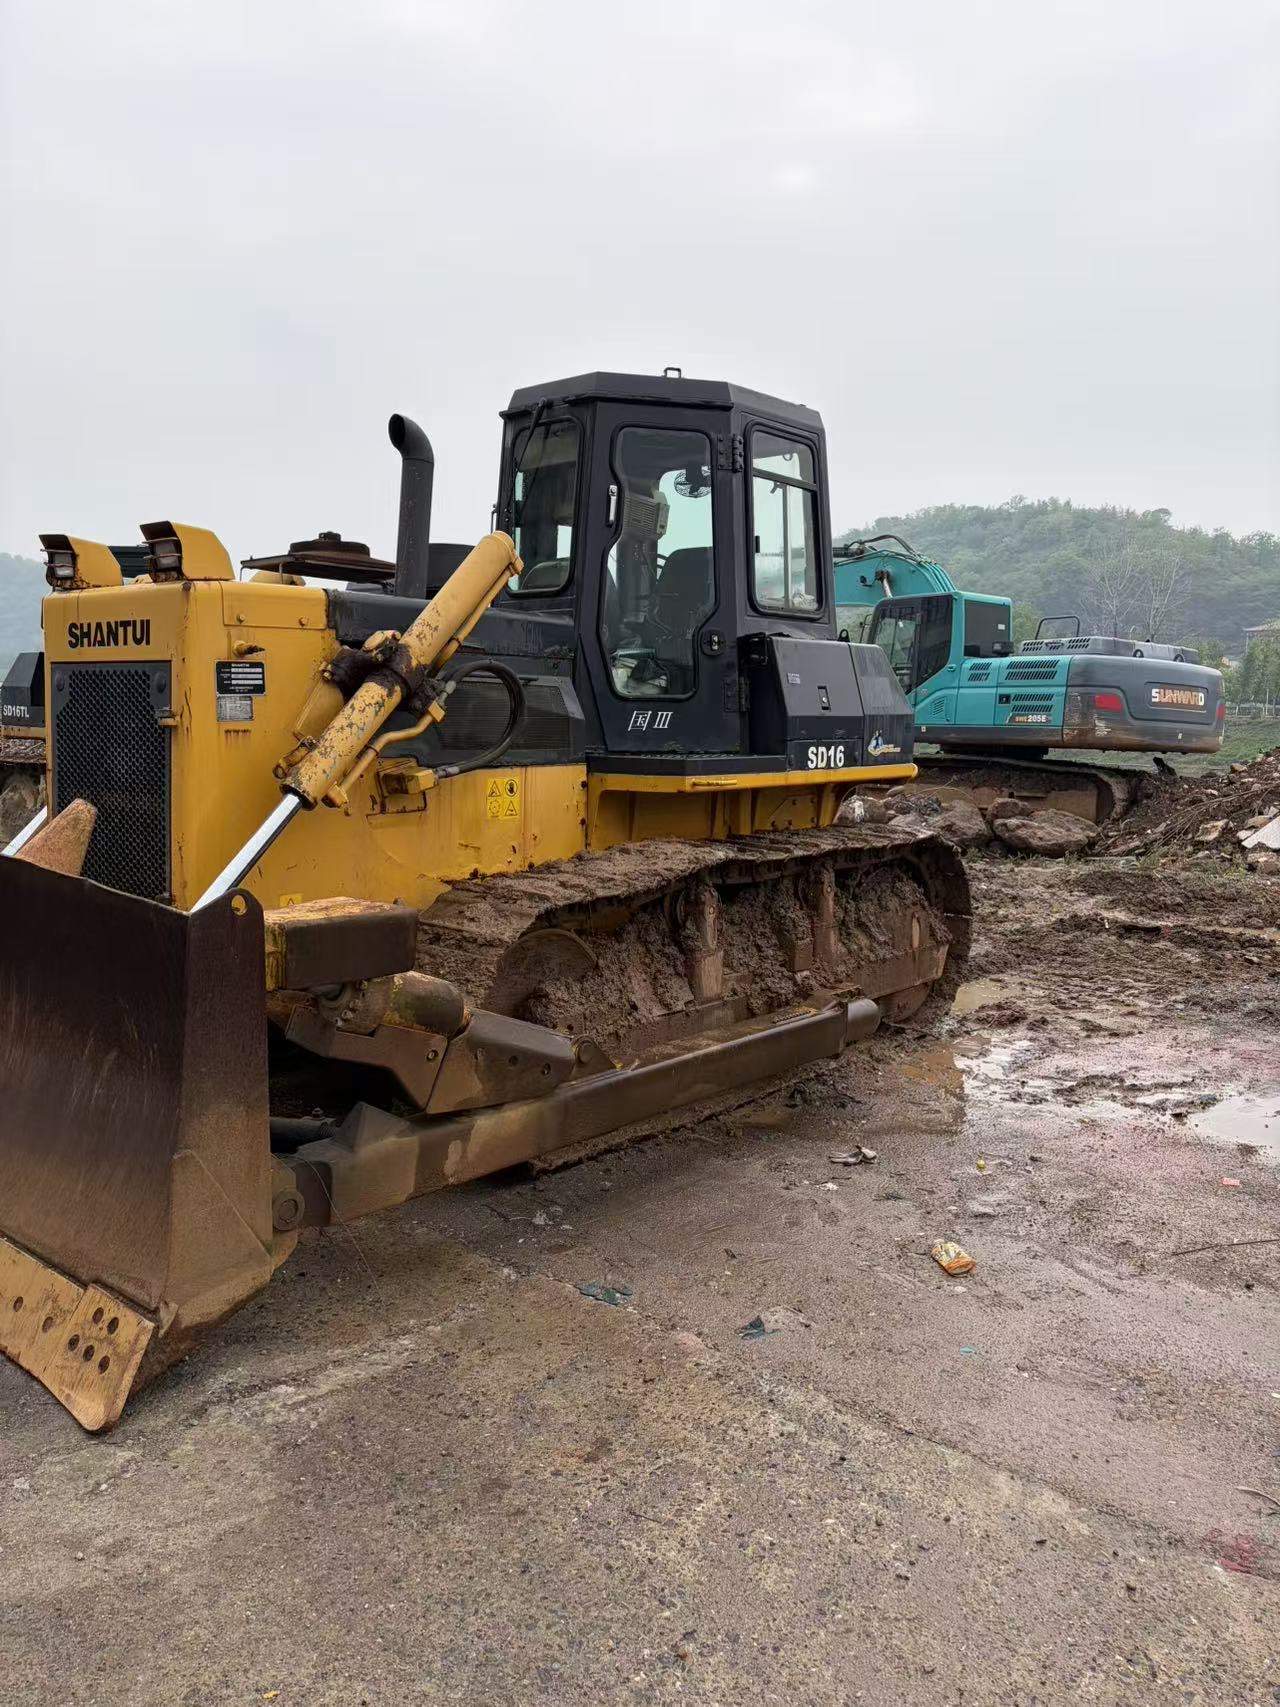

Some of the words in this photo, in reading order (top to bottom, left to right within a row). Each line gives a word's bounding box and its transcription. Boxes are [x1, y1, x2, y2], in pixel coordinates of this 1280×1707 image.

[67, 618, 151, 649] SHANTUI
[3, 704, 30, 718] SD16TL
[807, 745, 845, 769] SD16
